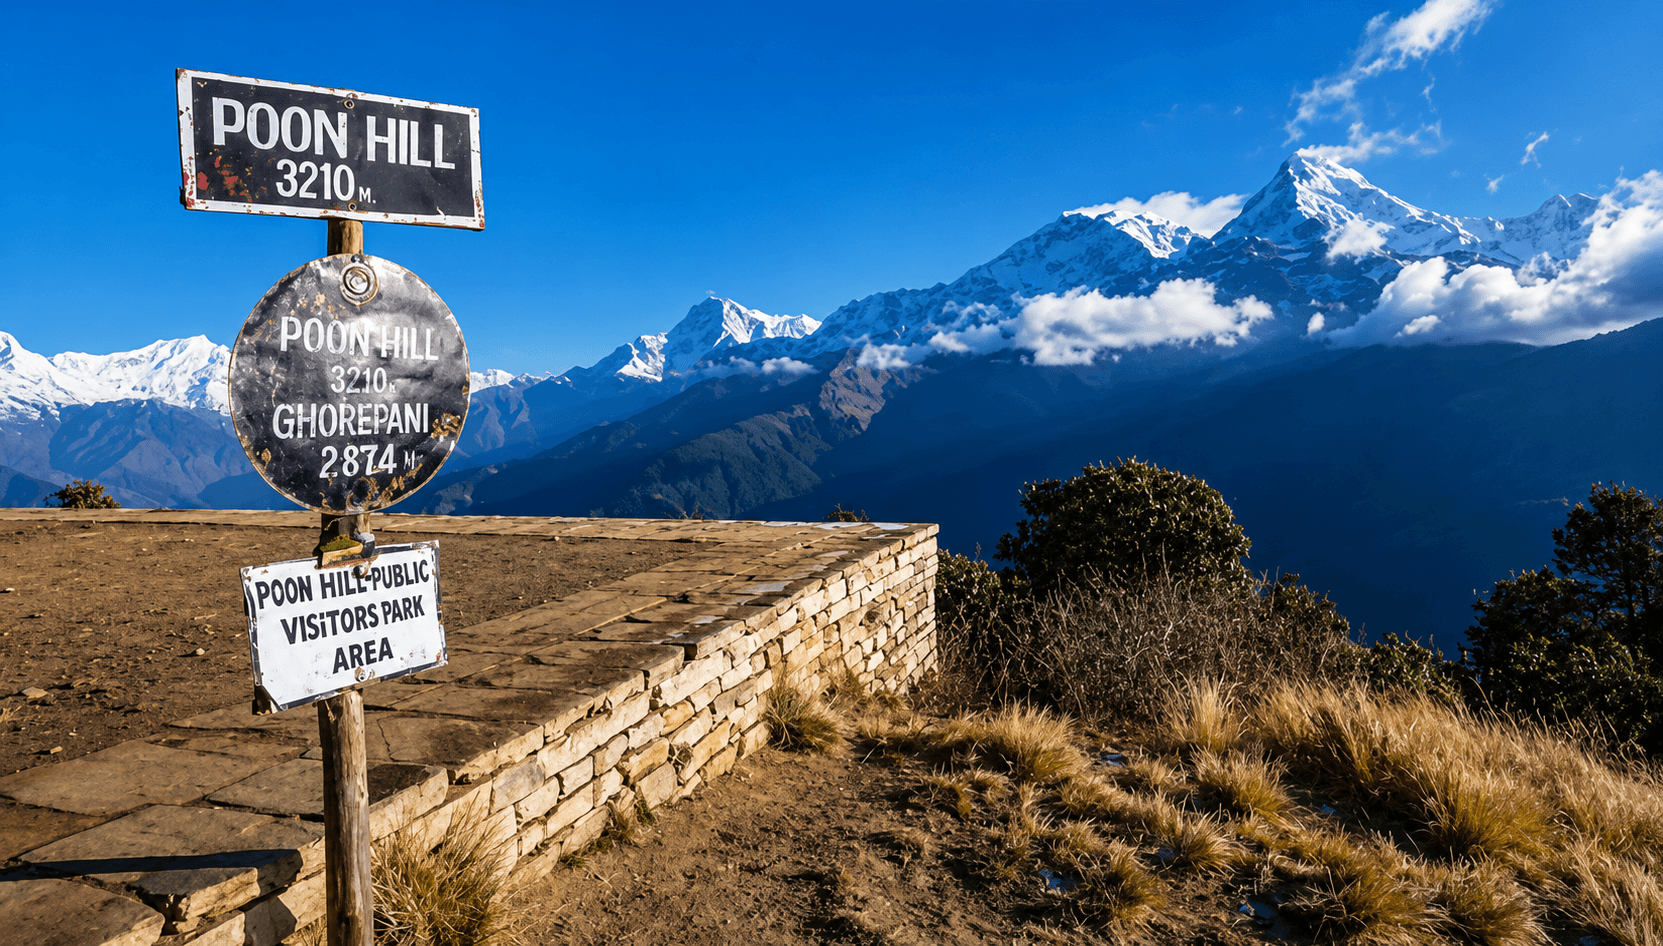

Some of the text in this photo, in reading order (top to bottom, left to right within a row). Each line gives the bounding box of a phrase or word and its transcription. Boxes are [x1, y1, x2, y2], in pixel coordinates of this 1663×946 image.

[211, 96, 456, 170] POON HILL
[276, 158, 356, 202] 3210
[279, 316, 439, 361] POON HILL
[330, 365, 387, 394] 3210
[272, 402, 429, 440] GHOREPANI
[319, 443, 398, 479] 2874
[255, 575, 314, 610] POON
[381, 594, 426, 625] PARK
[332, 636, 394, 675] AREA
